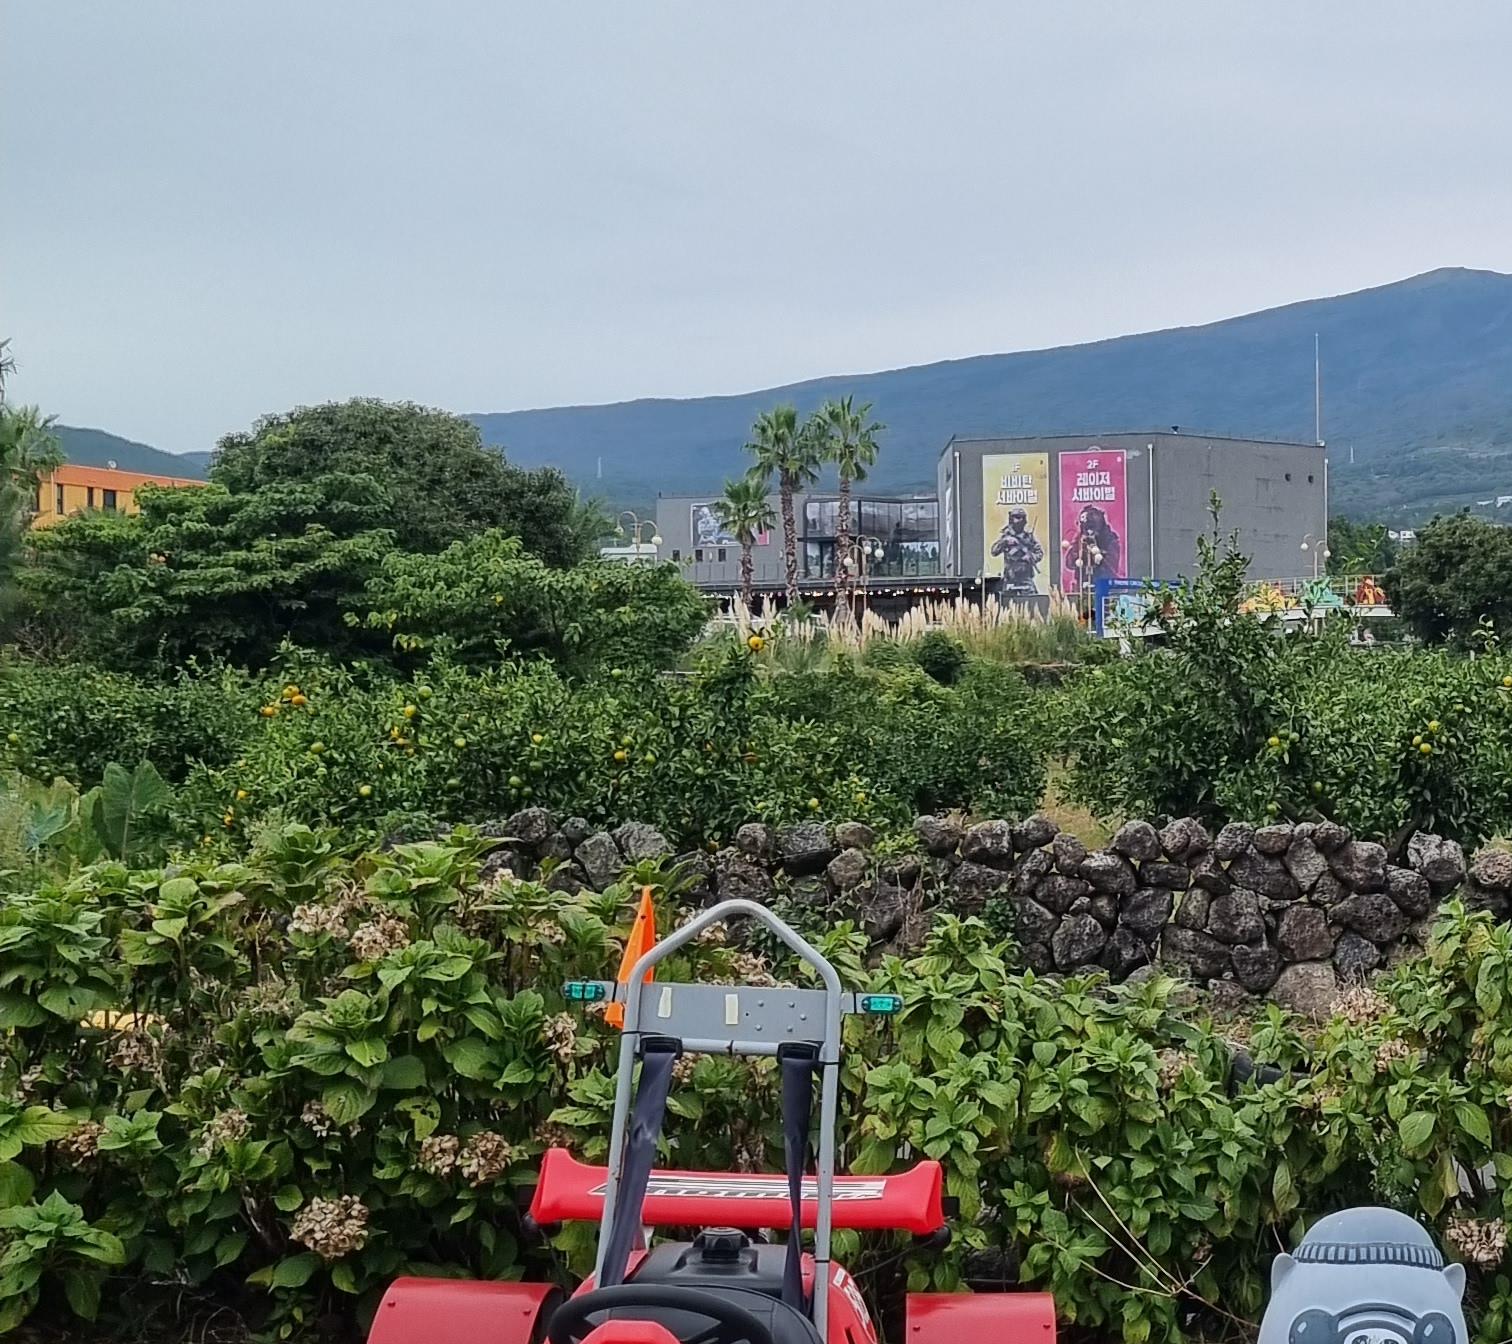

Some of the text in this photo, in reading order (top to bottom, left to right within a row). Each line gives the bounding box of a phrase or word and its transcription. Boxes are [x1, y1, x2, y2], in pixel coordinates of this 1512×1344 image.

[1087, 459, 1099, 470] 2F
[1001, 474, 1033, 489] 비비탄
[1076, 471, 1111, 487] 레이저
[995, 489, 1039, 505] 서바이벌
[1072, 486, 1115, 502] 서바이벌
